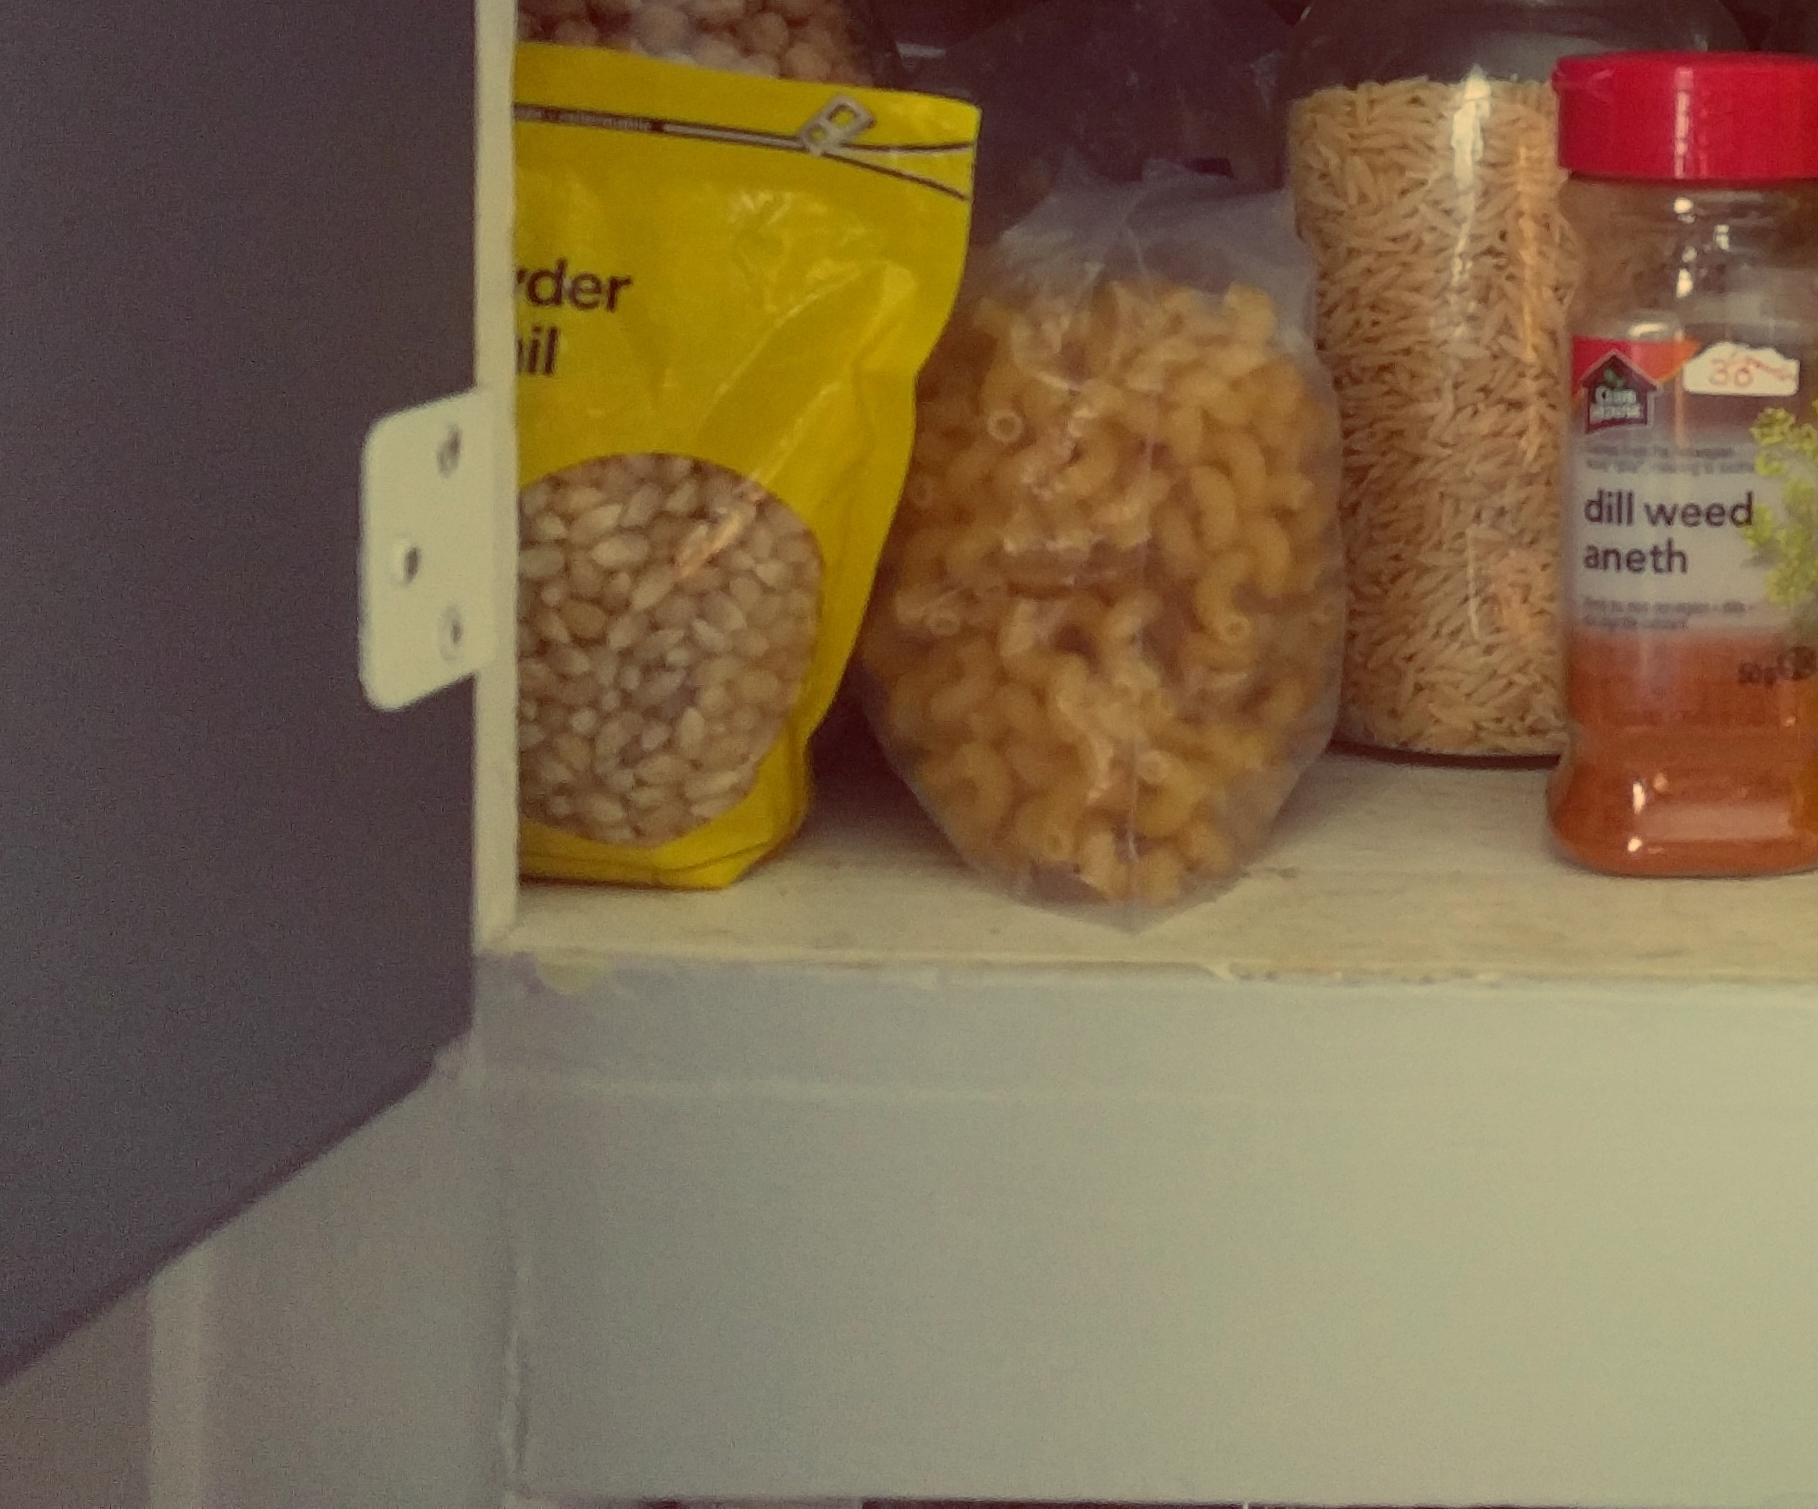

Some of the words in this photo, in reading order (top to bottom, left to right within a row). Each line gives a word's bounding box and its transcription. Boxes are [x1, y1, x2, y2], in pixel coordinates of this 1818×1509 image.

[515, 257, 633, 313] der
[1584, 490, 1634, 528] dill
[1644, 491, 1755, 528] weed
[1583, 538, 1688, 574] aneth
